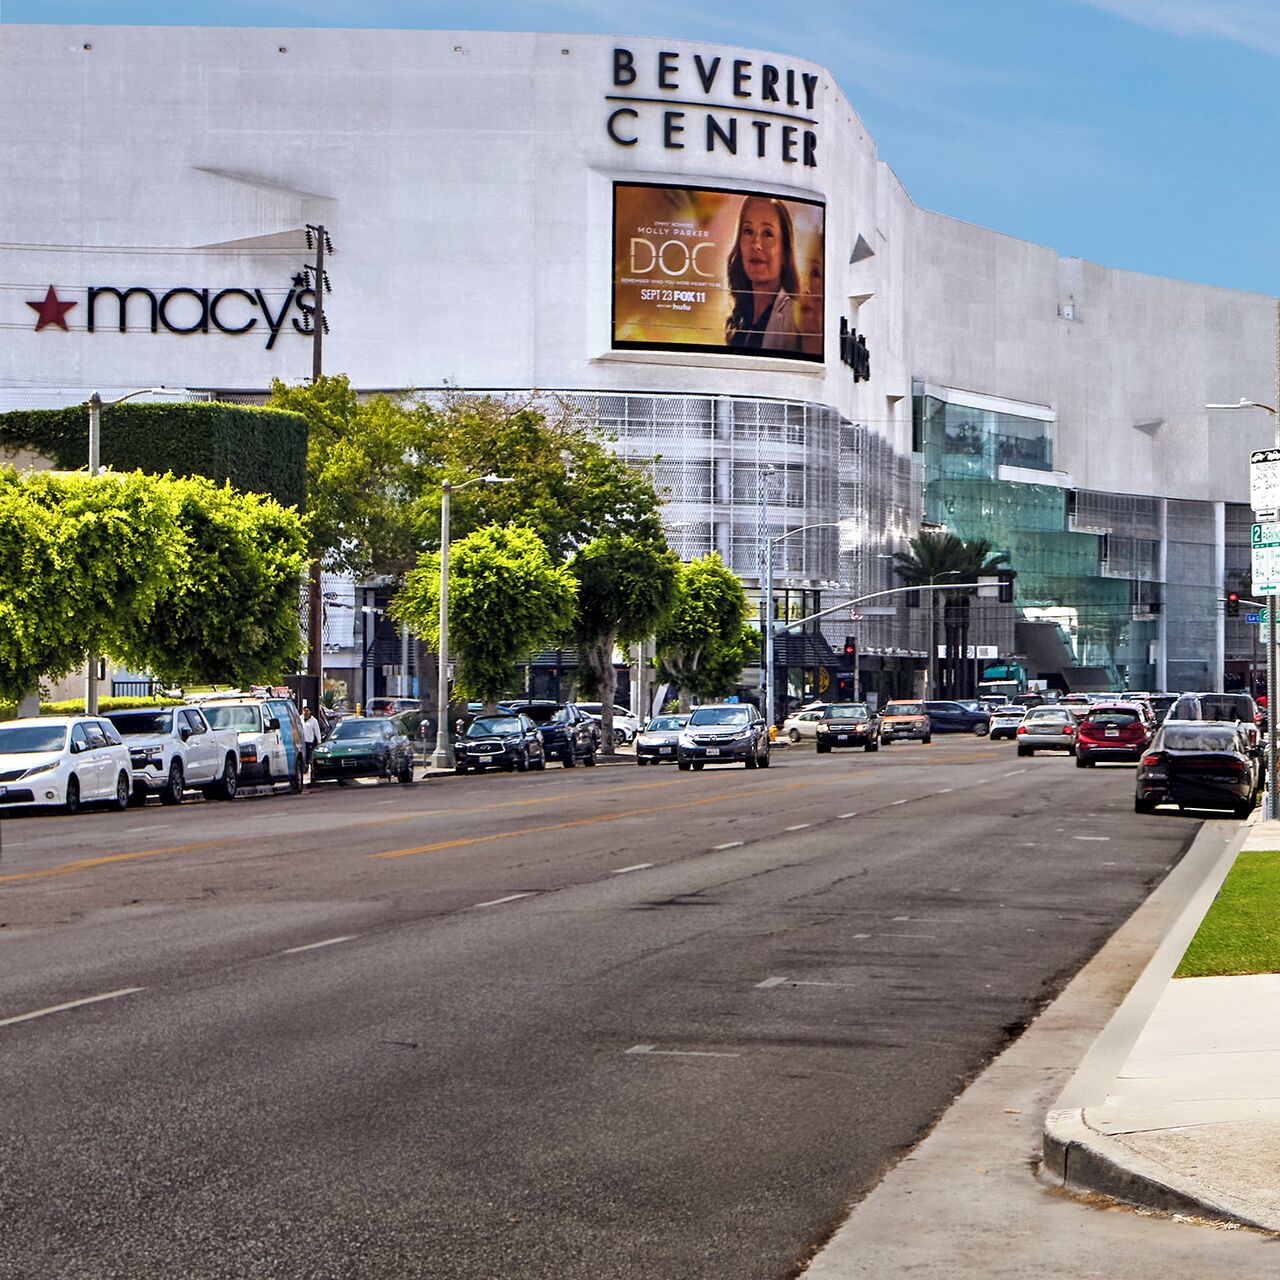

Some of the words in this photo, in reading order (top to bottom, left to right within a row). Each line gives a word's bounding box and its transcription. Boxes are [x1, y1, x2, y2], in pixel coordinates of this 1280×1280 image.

[613, 48, 819, 110] BEVERLY
[606, 108, 818, 168] CENTER
[637, 226, 670, 235] MOLLY
[673, 228, 710, 238] PARKER
[630, 237, 716, 277] DOC
[640, 289, 661, 300] SEPT
[662, 290, 673, 301] 23
[674, 291, 695, 302] FOX
[696, 292, 706, 303] 11
[672, 303, 691, 311] hulu
[1253, 526, 1261, 542] 2
